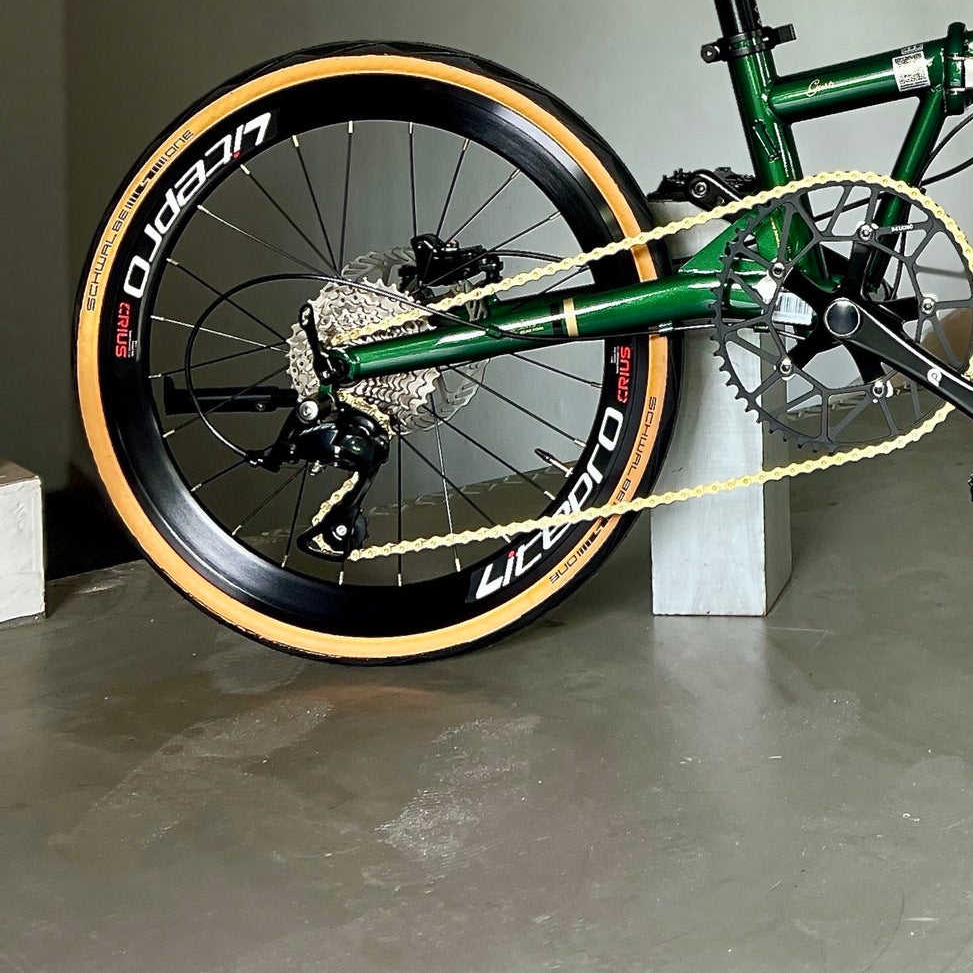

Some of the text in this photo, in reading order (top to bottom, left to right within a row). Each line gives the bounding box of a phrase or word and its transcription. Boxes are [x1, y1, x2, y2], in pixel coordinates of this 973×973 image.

[86, 129, 194, 312] SCHWALBE ONE
[115, 301, 131, 359] CRIUS
[617, 346, 632, 404] CRIUS
[548, 395, 657, 584] SCHWALBE ONE
